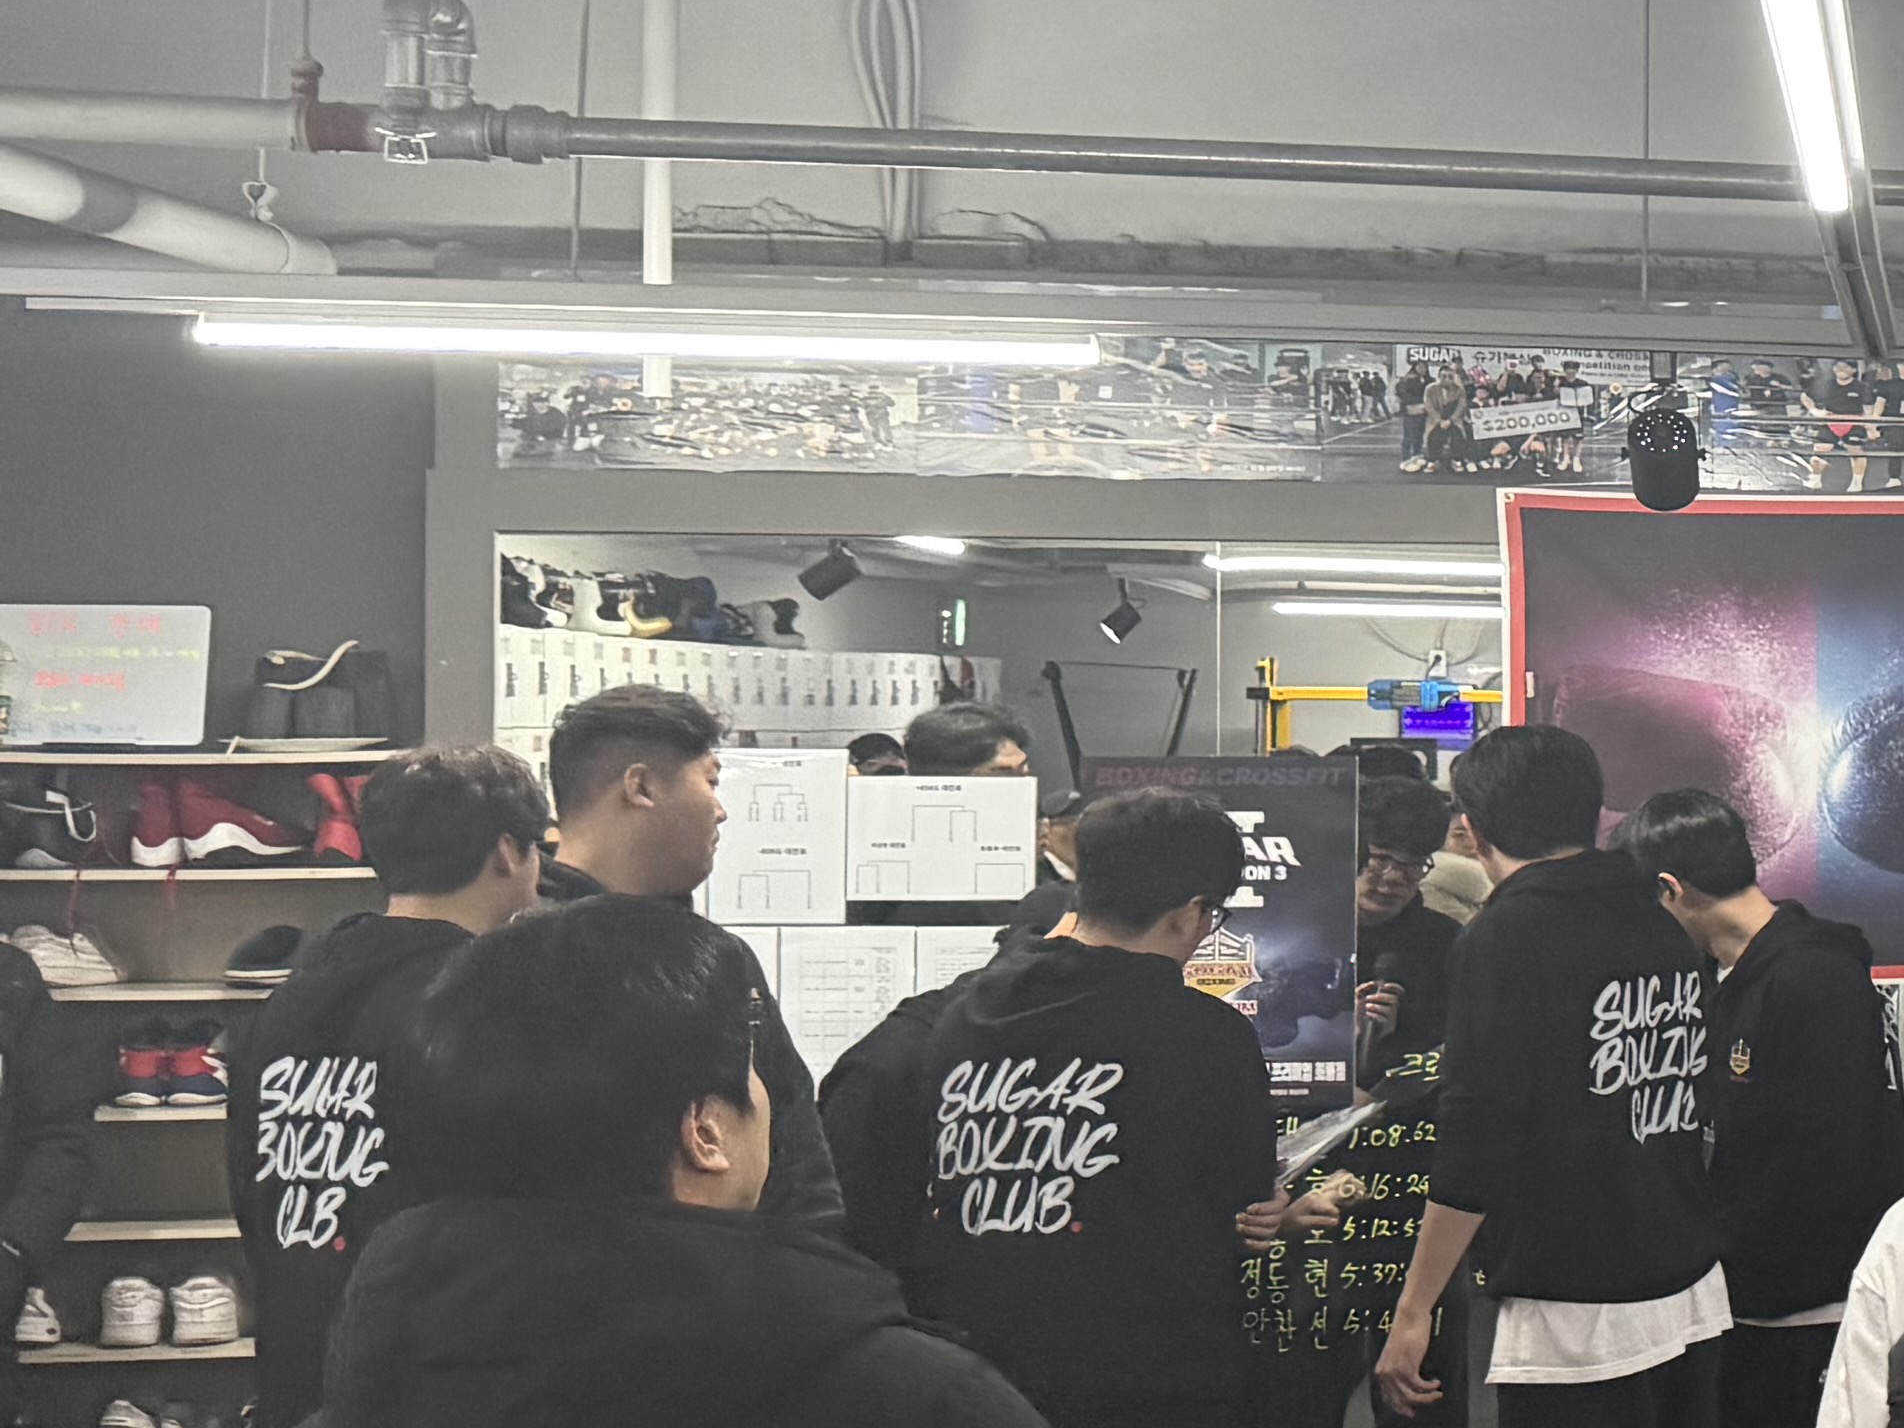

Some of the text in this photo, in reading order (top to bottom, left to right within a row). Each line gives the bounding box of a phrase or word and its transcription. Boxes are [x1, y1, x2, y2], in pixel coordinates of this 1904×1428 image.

[1590, 971, 1703, 1041] SUGAR
[937, 1057, 1125, 1124] SUGAR
[936, 1114, 1121, 1181] BOXING
